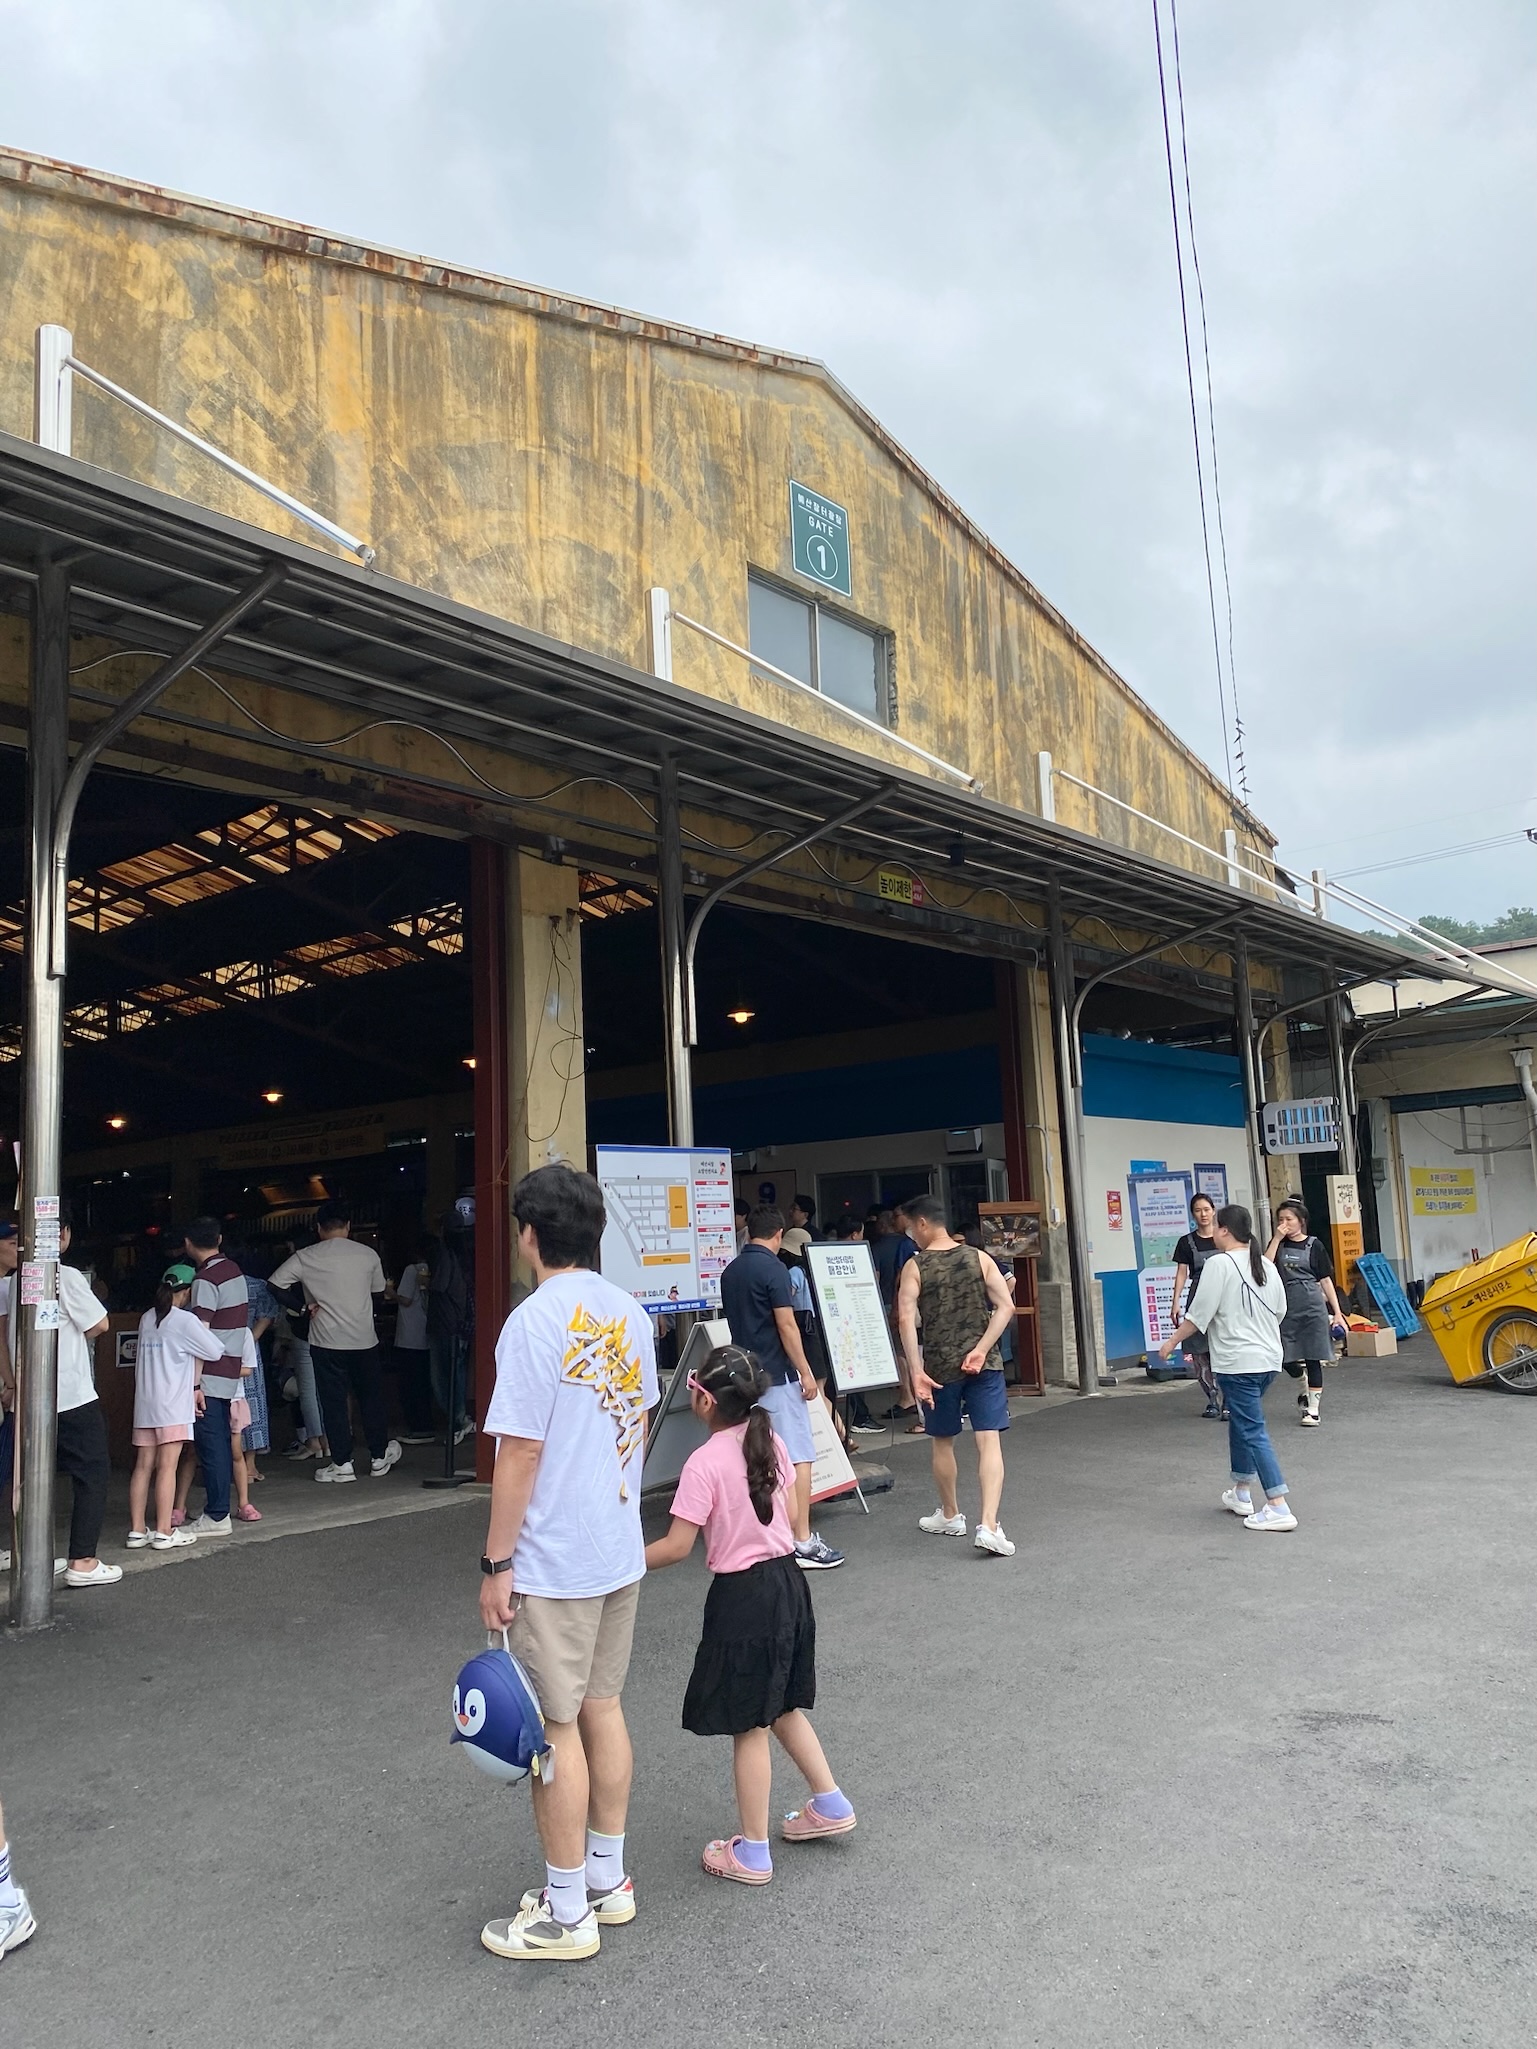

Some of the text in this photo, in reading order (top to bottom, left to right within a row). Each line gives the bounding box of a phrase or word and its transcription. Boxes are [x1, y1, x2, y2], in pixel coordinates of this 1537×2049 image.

[808, 515, 834, 538] GATE
[816, 544, 826, 572] 1
[759, 1182, 776, 1204] 9
[828, 1265, 857, 1275] 매장안내
[1473, 1280, 1512, 1303] 예산읍사무소
